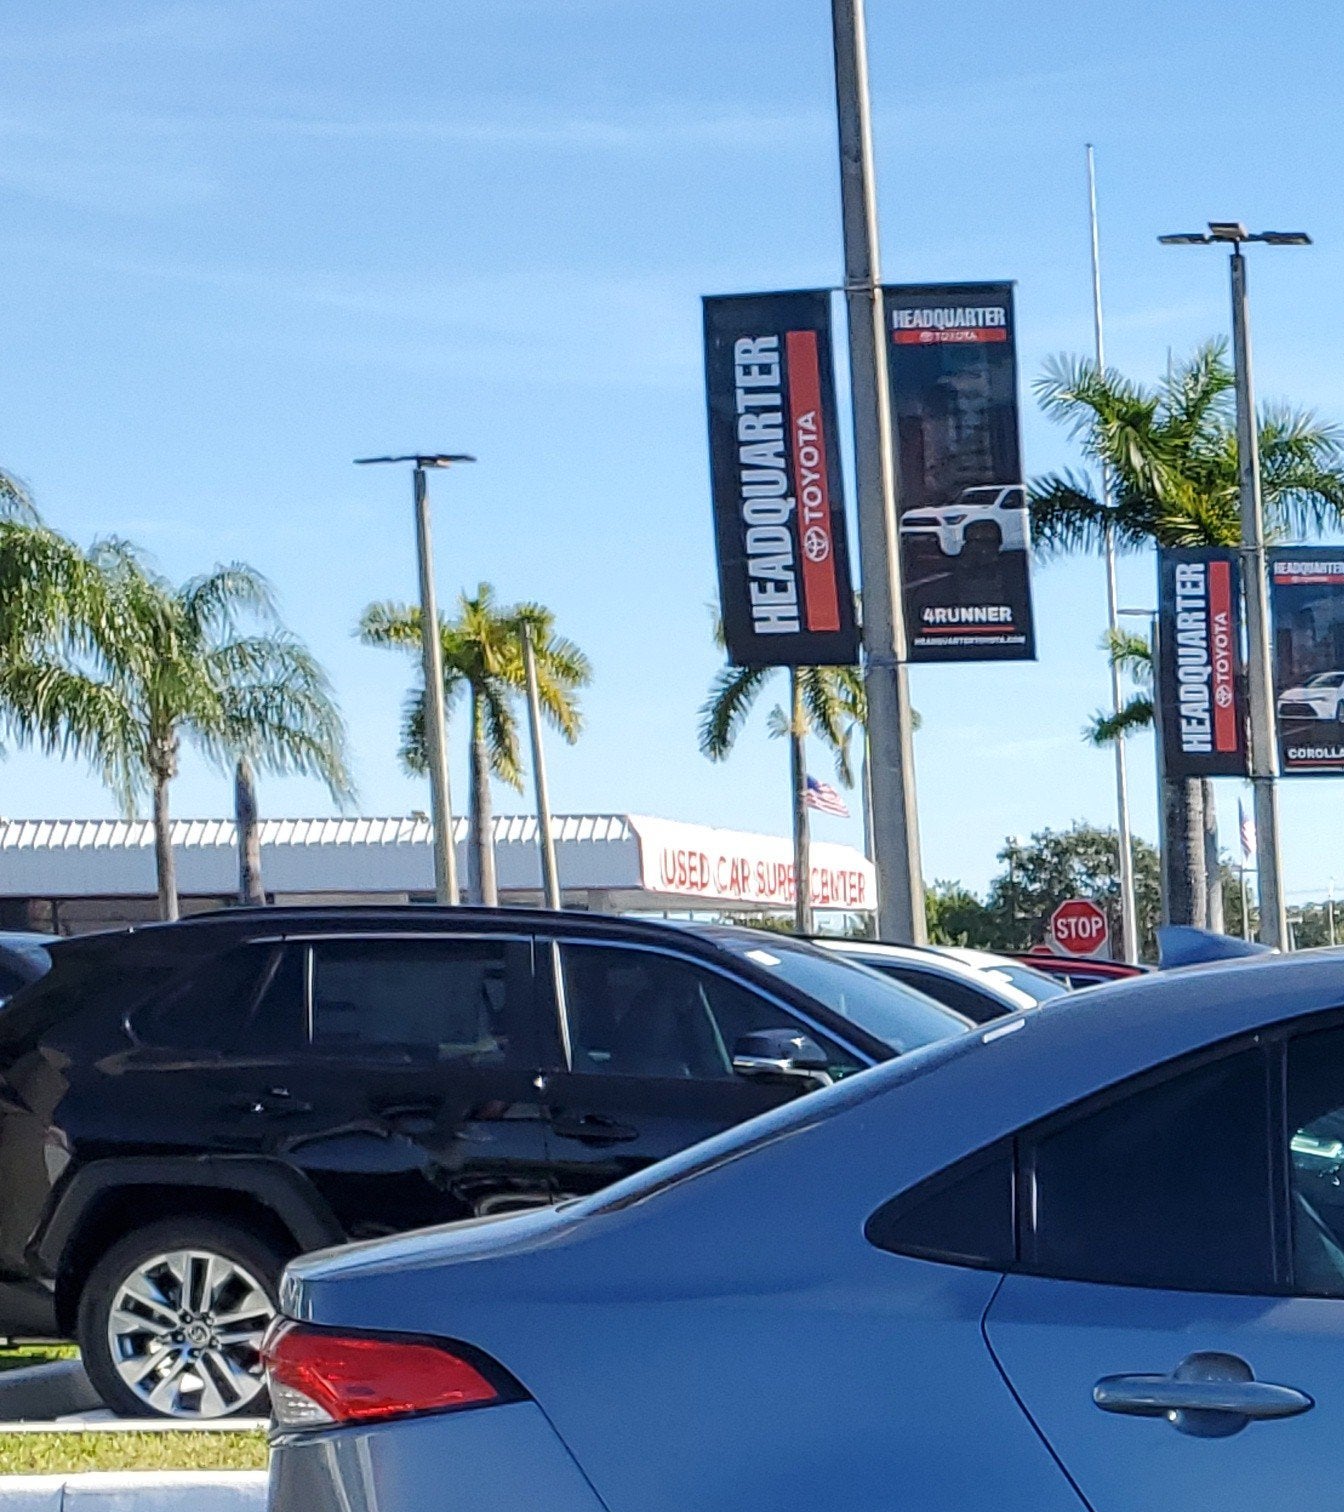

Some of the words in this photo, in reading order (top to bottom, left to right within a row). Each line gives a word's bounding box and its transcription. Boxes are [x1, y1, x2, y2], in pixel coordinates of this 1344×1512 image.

[892, 307, 1006, 329] HEADQUARTER
[734, 334, 800, 634] HEADQUARTER
[797, 411, 825, 525] TOYOTA
[923, 606, 1013, 623] 4RUNNER
[1214, 611, 1230, 682] TOYOTA
[1175, 563, 1212, 752] HEADQUARTER
[662, 848, 710, 890] USED
[714, 855, 751, 896] CAR
[755, 860, 798, 902] SUPE
[809, 867, 867, 906] CENTER
[1056, 915, 1103, 939] STOP
